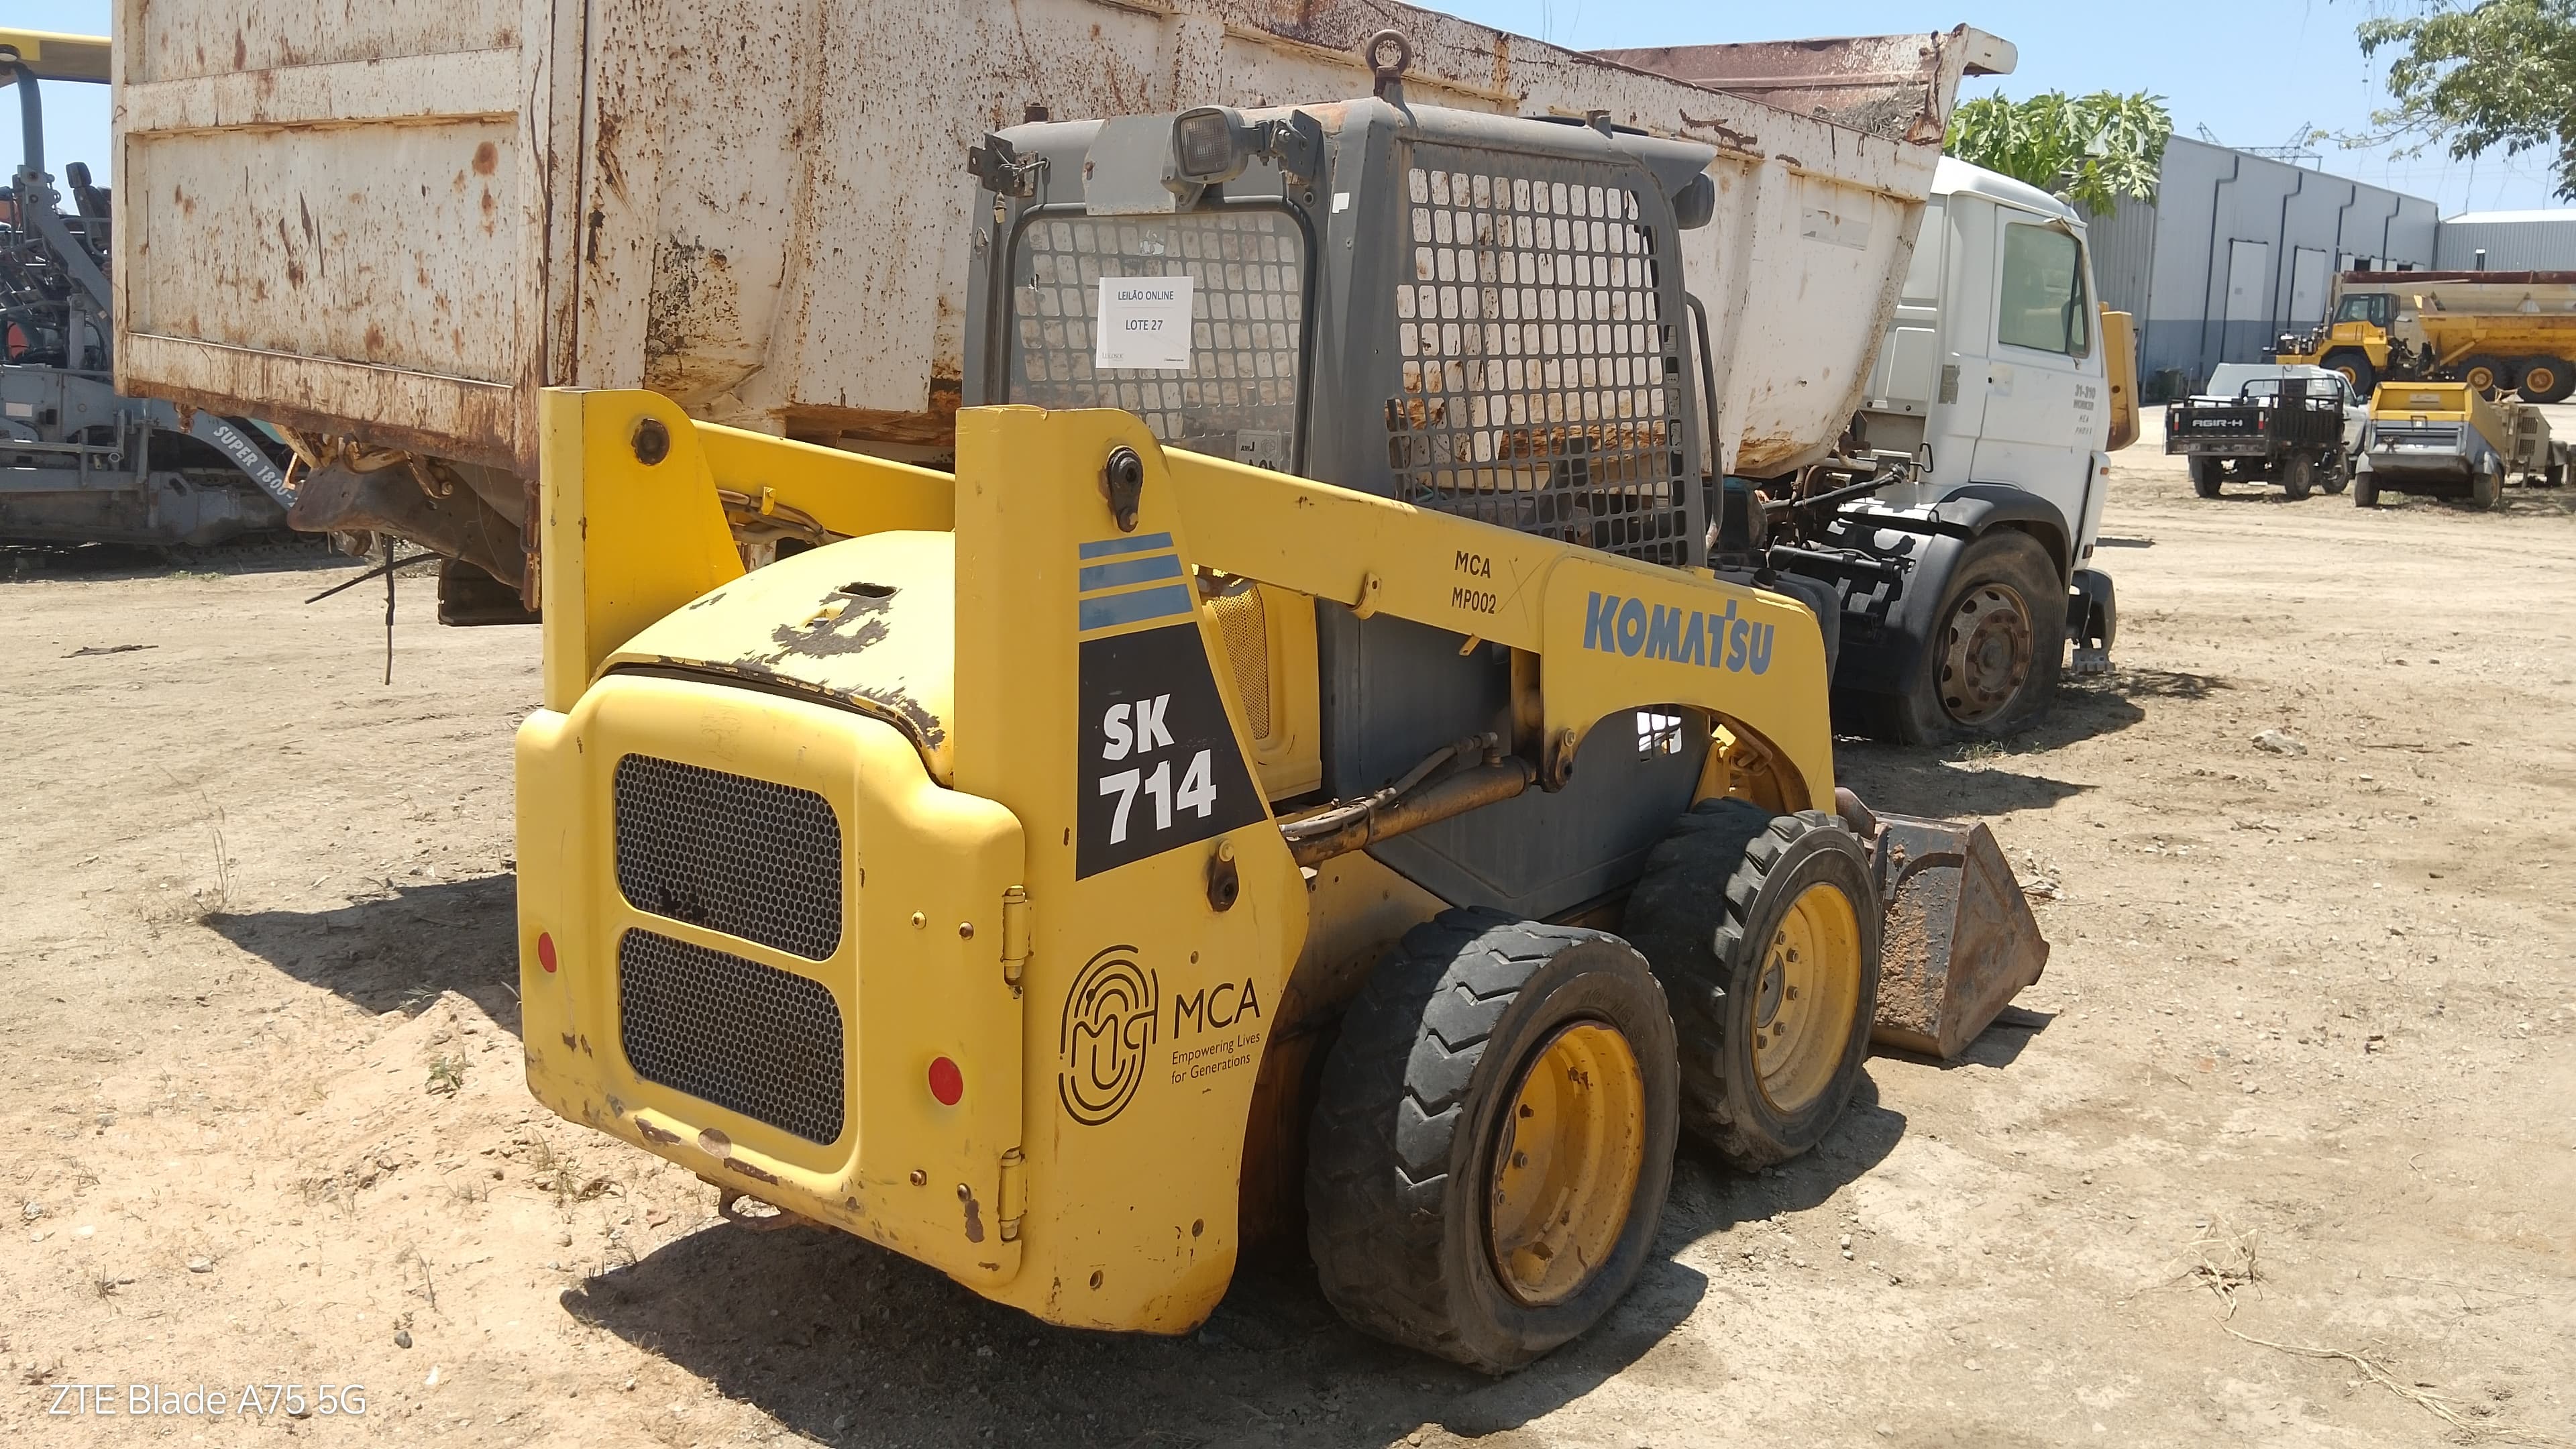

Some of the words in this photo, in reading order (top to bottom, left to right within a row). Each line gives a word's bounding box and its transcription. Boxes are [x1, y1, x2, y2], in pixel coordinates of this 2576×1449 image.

[1118, 290, 1144, 301] LEILÃO
[1145, 290, 1174, 300] ONLINE
[1126, 319, 1149, 331] LOTE
[1151, 319, 1163, 331] 27
[213, 426, 258, 467] SUPER
[1454, 550, 1491, 579] MCA
[1452, 587, 1497, 614] MP002
[1583, 591, 1774, 675] KOMATSU
[1102, 694, 1175, 761] SK
[1099, 749, 1217, 845] 714
[1173, 977, 1260, 1039] MCA
[1172, 1039, 1234, 1065] Empowering
[1237, 1032, 1260, 1048] Lives
[1171, 1070, 1187, 1084] for
[1190, 1053, 1250, 1079] Generations
